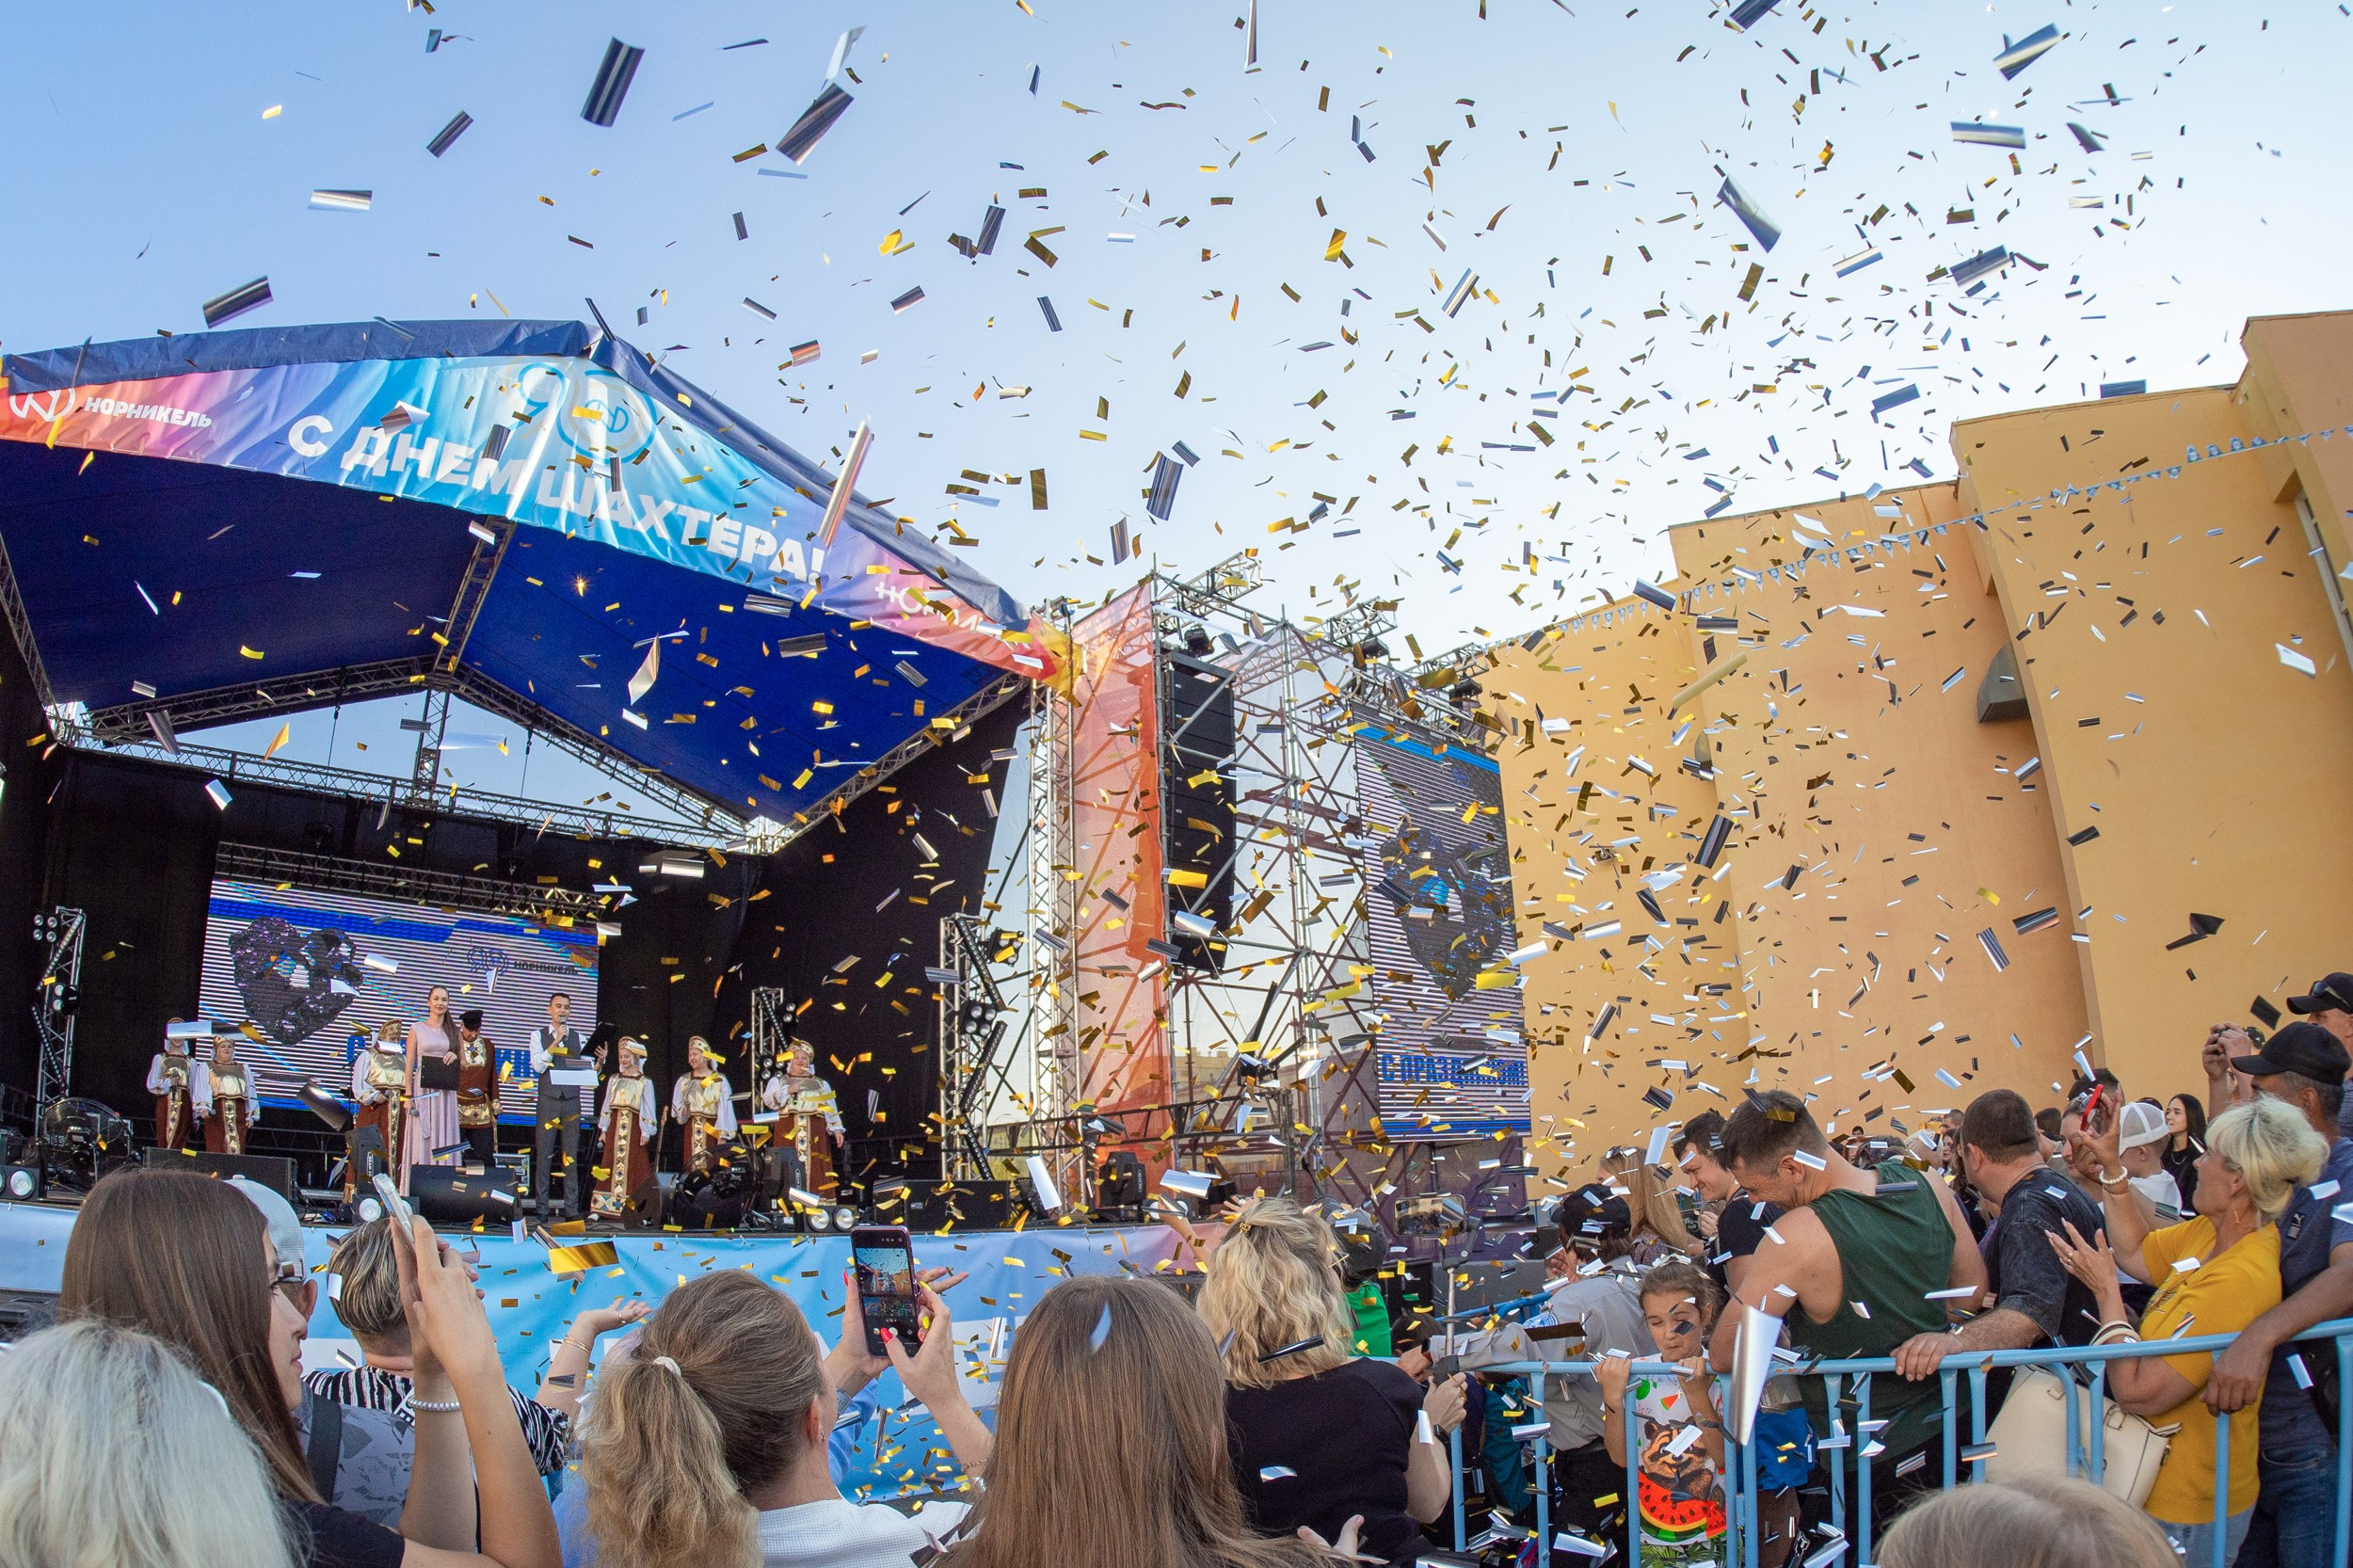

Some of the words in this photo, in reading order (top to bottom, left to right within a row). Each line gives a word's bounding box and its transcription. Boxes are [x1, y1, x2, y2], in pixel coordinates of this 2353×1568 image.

[84, 396, 212, 427] НОРНИКЕЛЬ
[288, 415, 333, 457] С
[340, 426, 528, 495] ДНЕМ
[536, 467, 824, 586] ШАХТЕРА!
